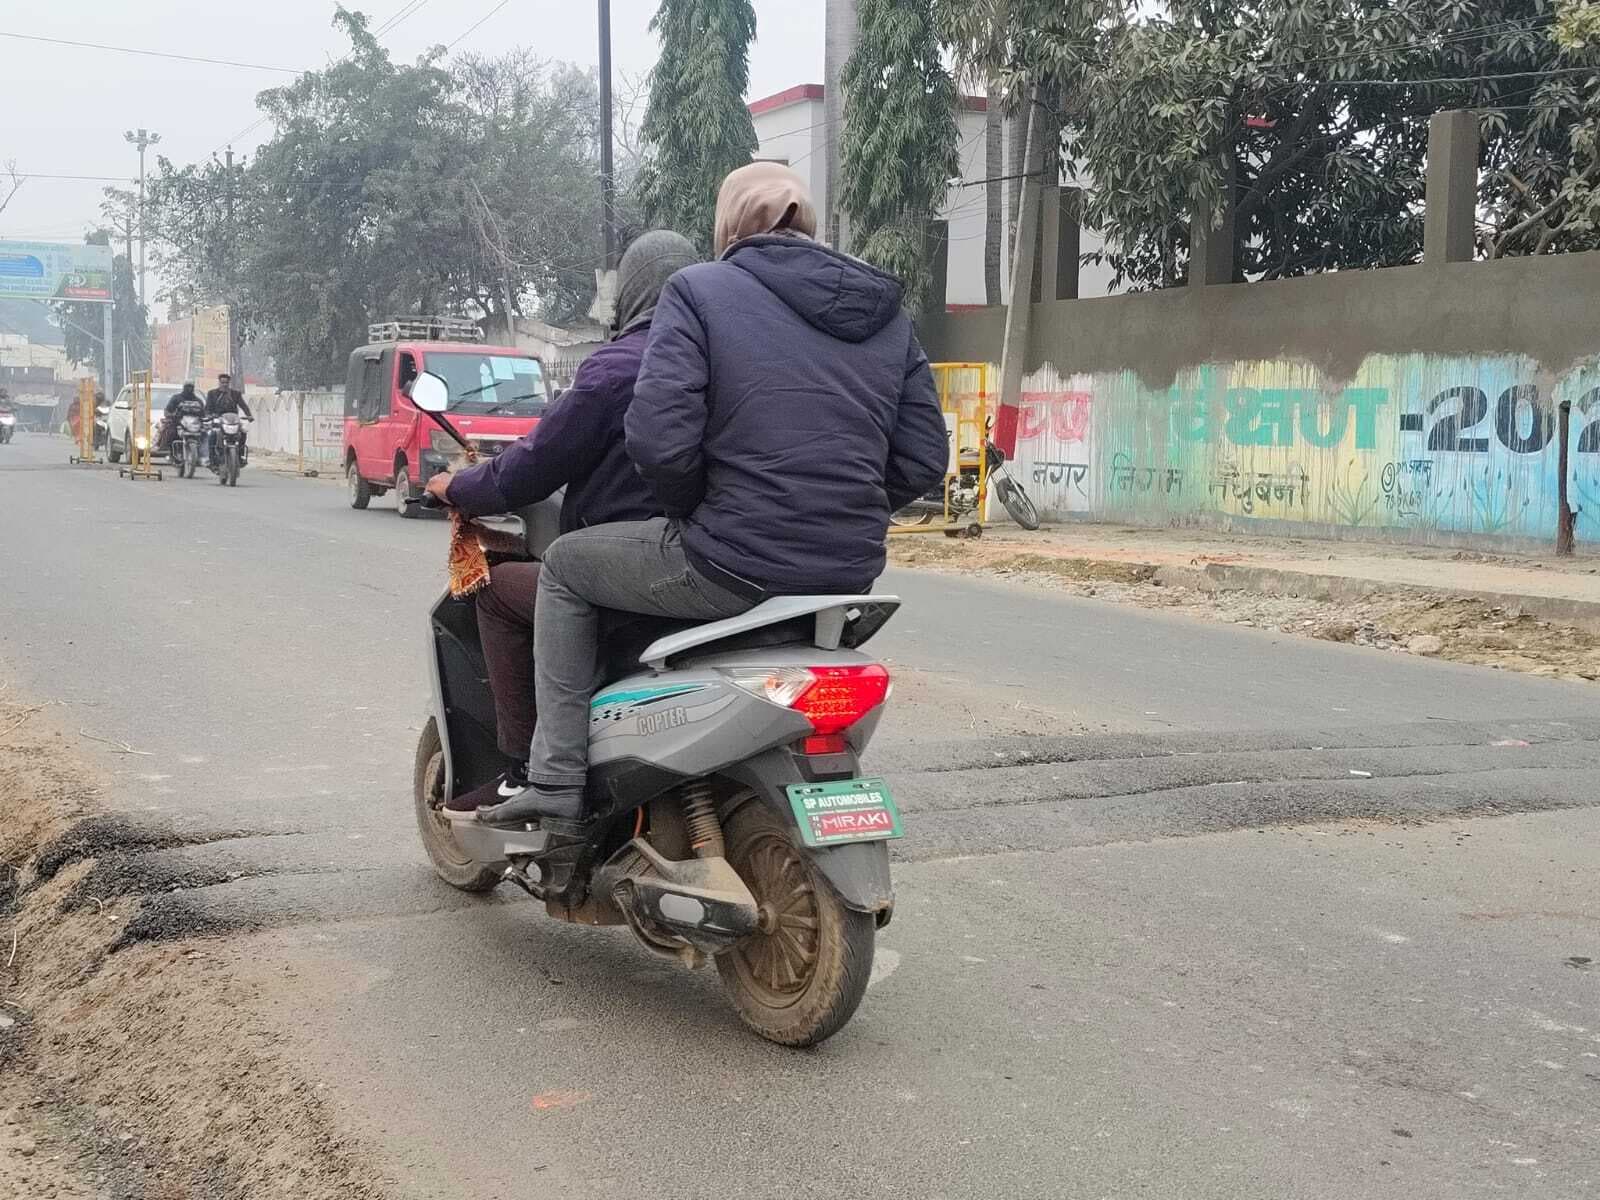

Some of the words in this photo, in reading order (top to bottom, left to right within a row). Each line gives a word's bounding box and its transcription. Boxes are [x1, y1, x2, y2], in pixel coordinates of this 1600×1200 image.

[1033, 462, 1089, 497] नगर
[639, 706, 687, 737] COPTER
[803, 797, 817, 809] SP
[818, 792, 883, 808] AUTOMOBILES
[821, 812, 889, 829] MIRAKI
